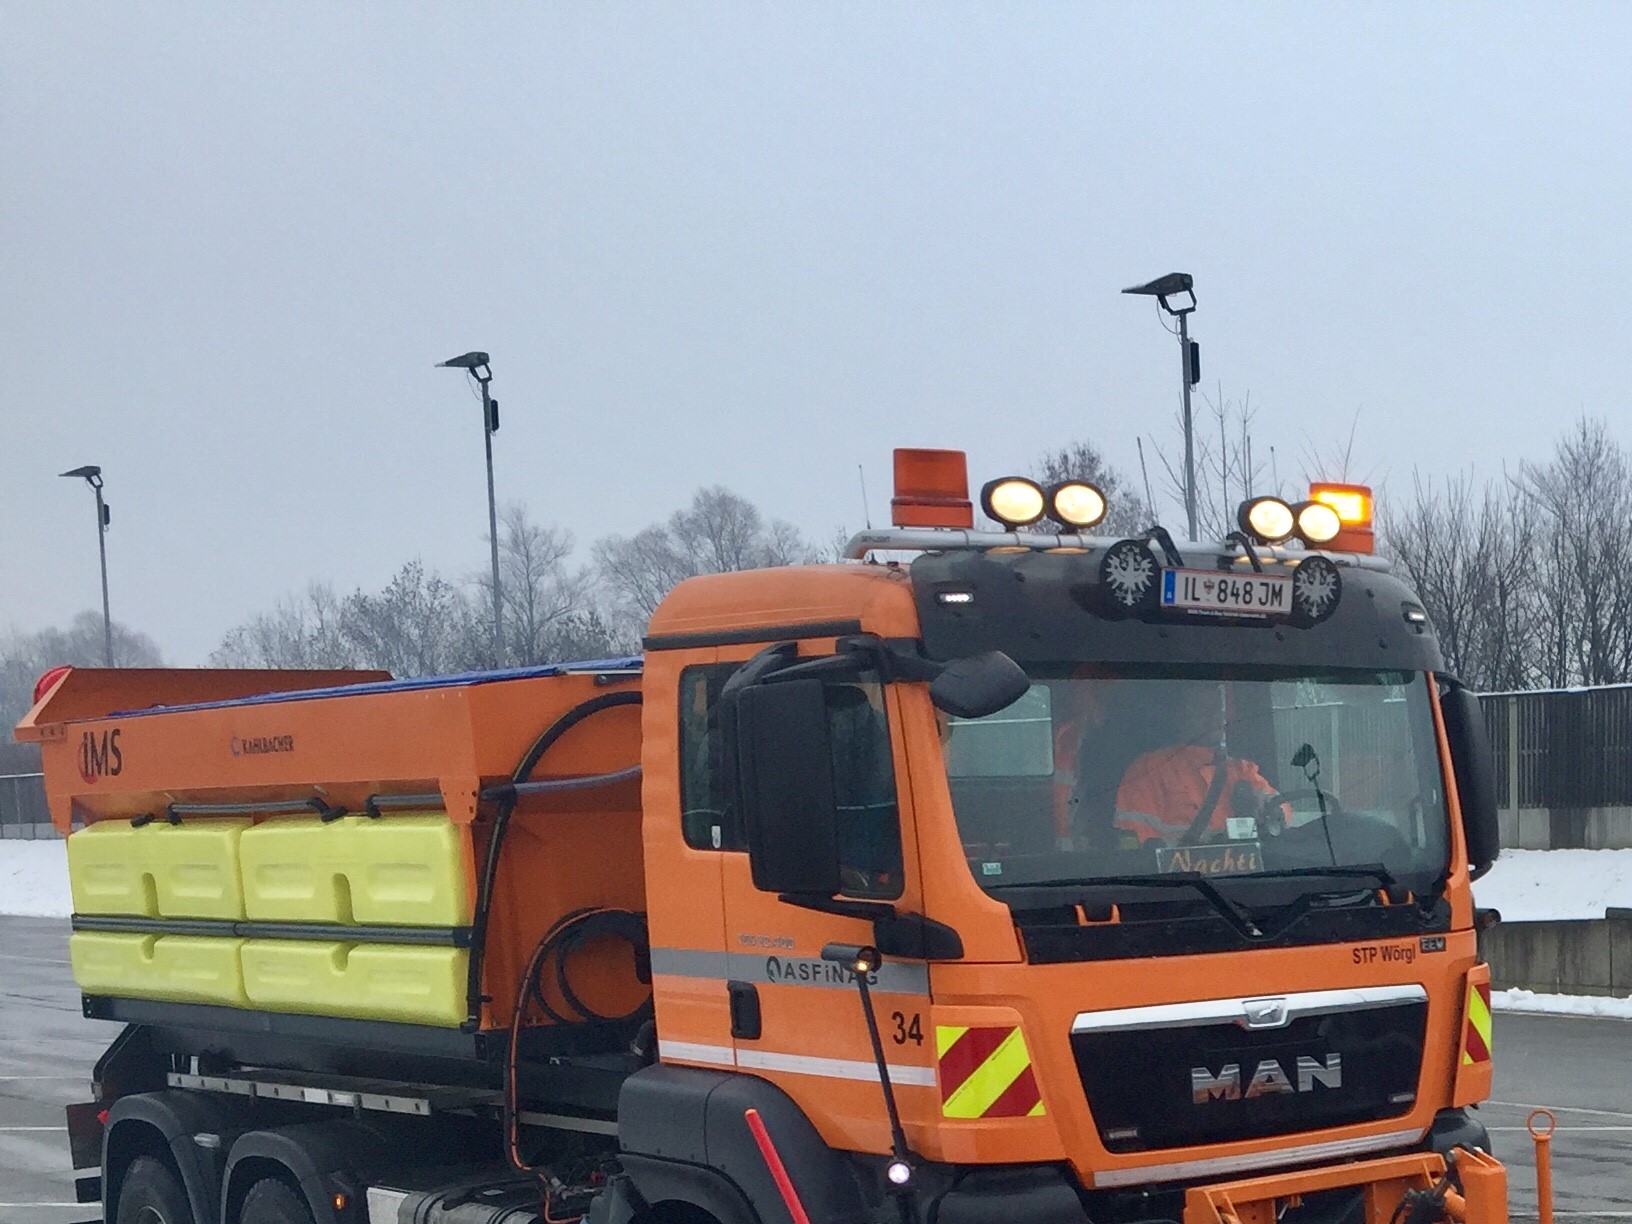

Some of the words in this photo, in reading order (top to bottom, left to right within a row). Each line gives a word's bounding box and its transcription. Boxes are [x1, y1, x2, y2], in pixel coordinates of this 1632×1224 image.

[1184, 577, 1201, 602] IL
[1217, 579, 1254, 605] 848
[1258, 582, 1283, 607] JM
[241, 735, 295, 754] KAHLBACHER
[1352, 946, 1378, 964] STP
[1380, 943, 1416, 964] Wörgl
[892, 1011, 924, 1046] 34
[1191, 1053, 1342, 1104] MAN
